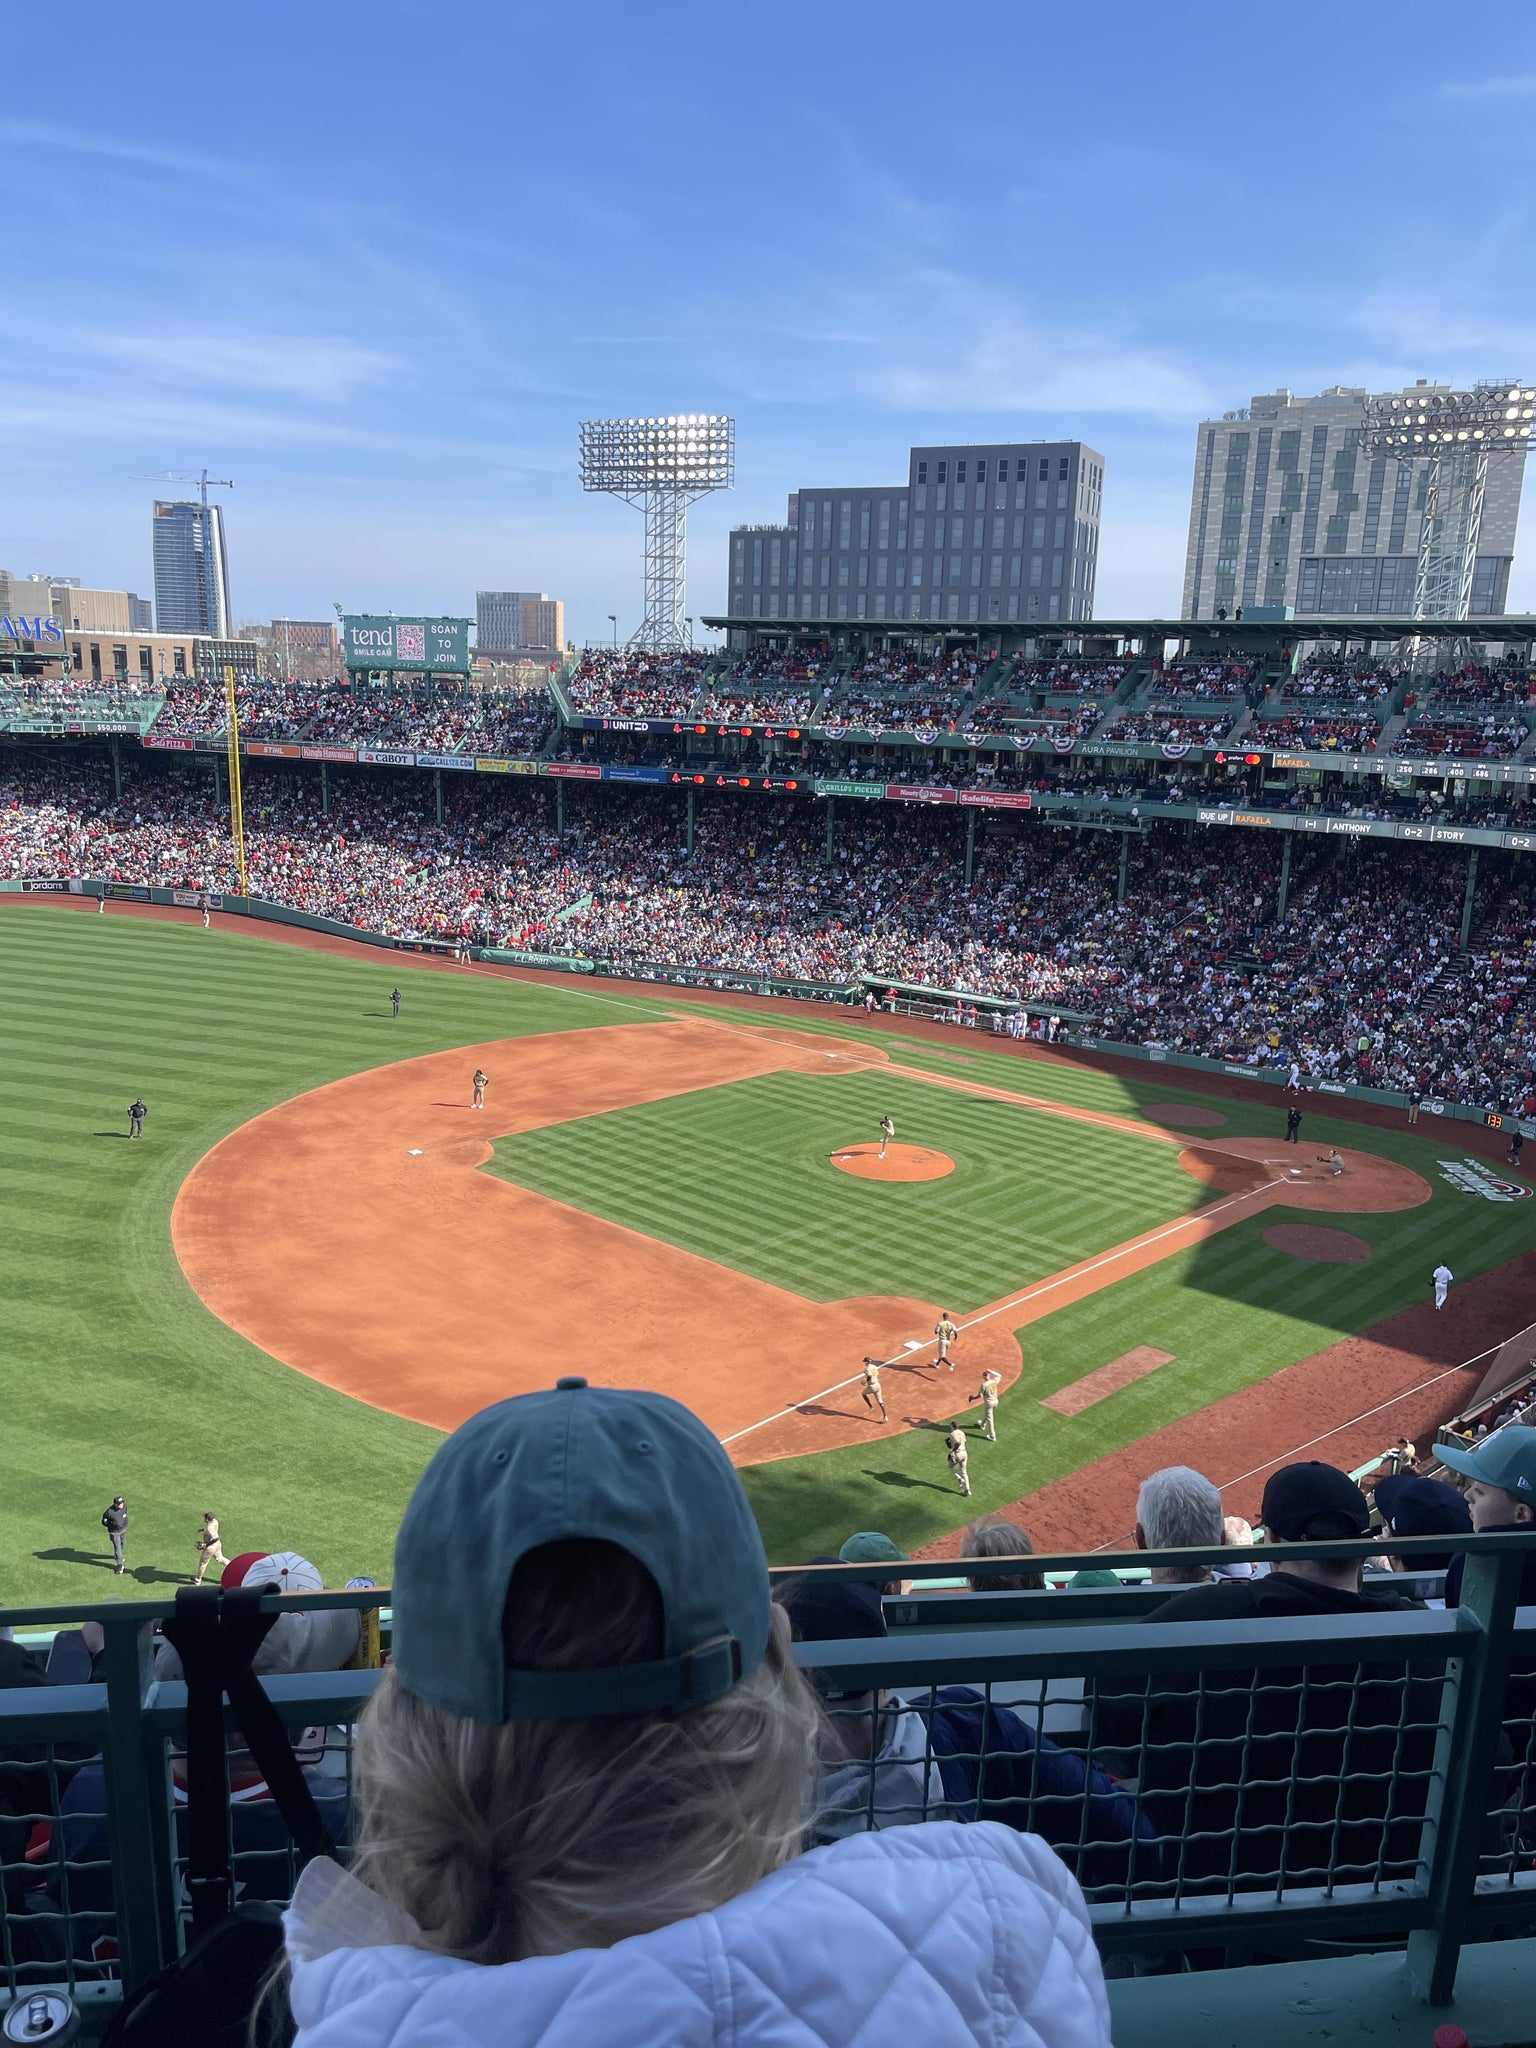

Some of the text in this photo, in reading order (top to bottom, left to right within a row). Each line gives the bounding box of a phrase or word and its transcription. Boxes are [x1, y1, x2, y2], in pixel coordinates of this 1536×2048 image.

[431, 625, 458, 634] SCAN
[351, 626, 393, 646] tend
[438, 639, 451, 648] TO
[354, 648, 375, 656] SMILE
[433, 654, 457, 663] JOIN
[97, 724, 127, 732] $50,000
[612, 720, 649, 731] UNITED
[166, 740, 186, 749] PIZZA
[263, 746, 285, 755] STIHL
[1106, 747, 1139, 756] PAVILION
[1276, 759, 1311, 768] RAFAELA
[854, 786, 881, 794] PICKLES
[900, 789, 919, 797] Ninety
[961, 794, 995, 804] Safelite
[1200, 812, 1229, 821] DUE UP
[1235, 815, 1272, 825] RAFAELA
[1332, 822, 1372, 833] ANTHONY
[1404, 827, 1423, 838] 0-2
[1436, 830, 1465, 841] STORY
[1511, 837, 1531, 848] 0-2
[1224, 1065, 1259, 1077] smartwater
[1318, 1081, 1347, 1093] Franklin
